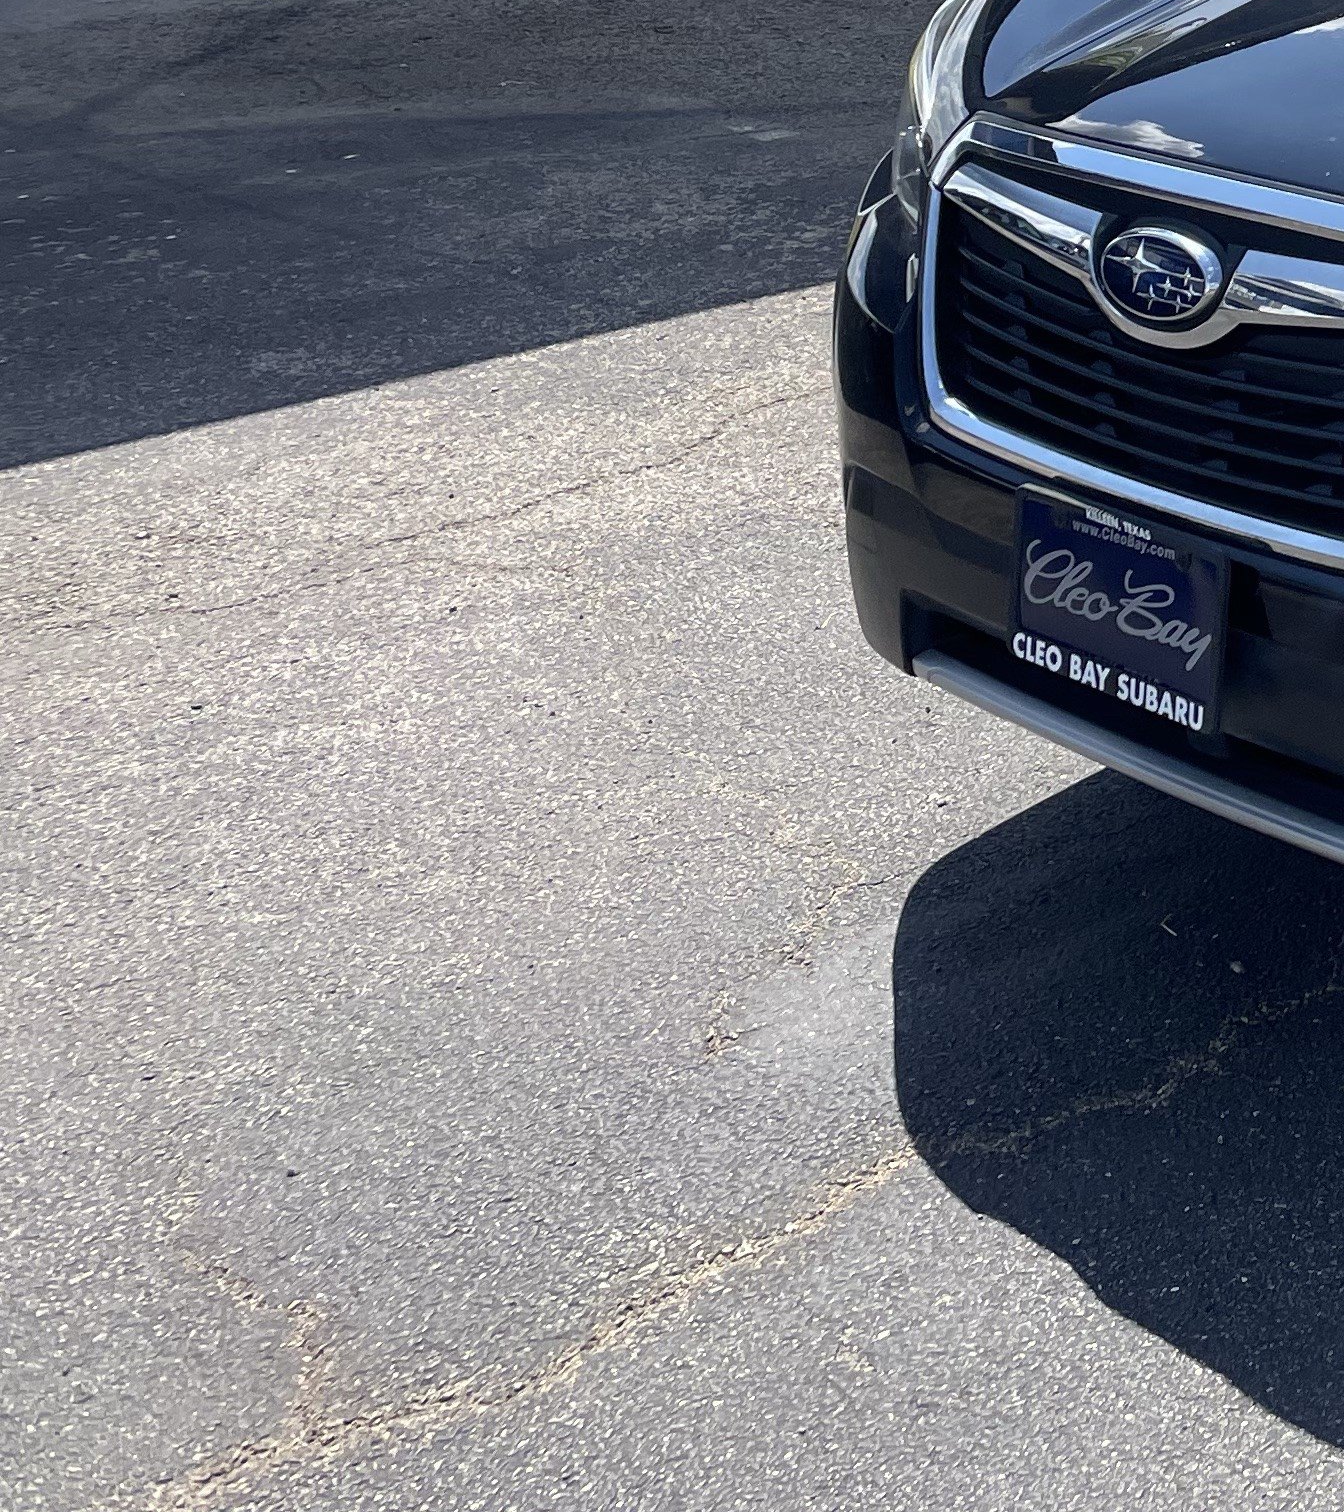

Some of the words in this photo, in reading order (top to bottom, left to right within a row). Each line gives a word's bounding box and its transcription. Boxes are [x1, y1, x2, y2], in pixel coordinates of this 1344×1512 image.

[1072, 520, 1176, 560] www.CleoBay.com
[1122, 520, 1151, 541] TEXAS
[1023, 538, 1118, 621] Cleo
[1116, 569, 1213, 672] Bay
[1012, 632, 1062, 673] CLEO
[1068, 653, 1111, 693] BAY
[1116, 673, 1204, 731] SUBARU
